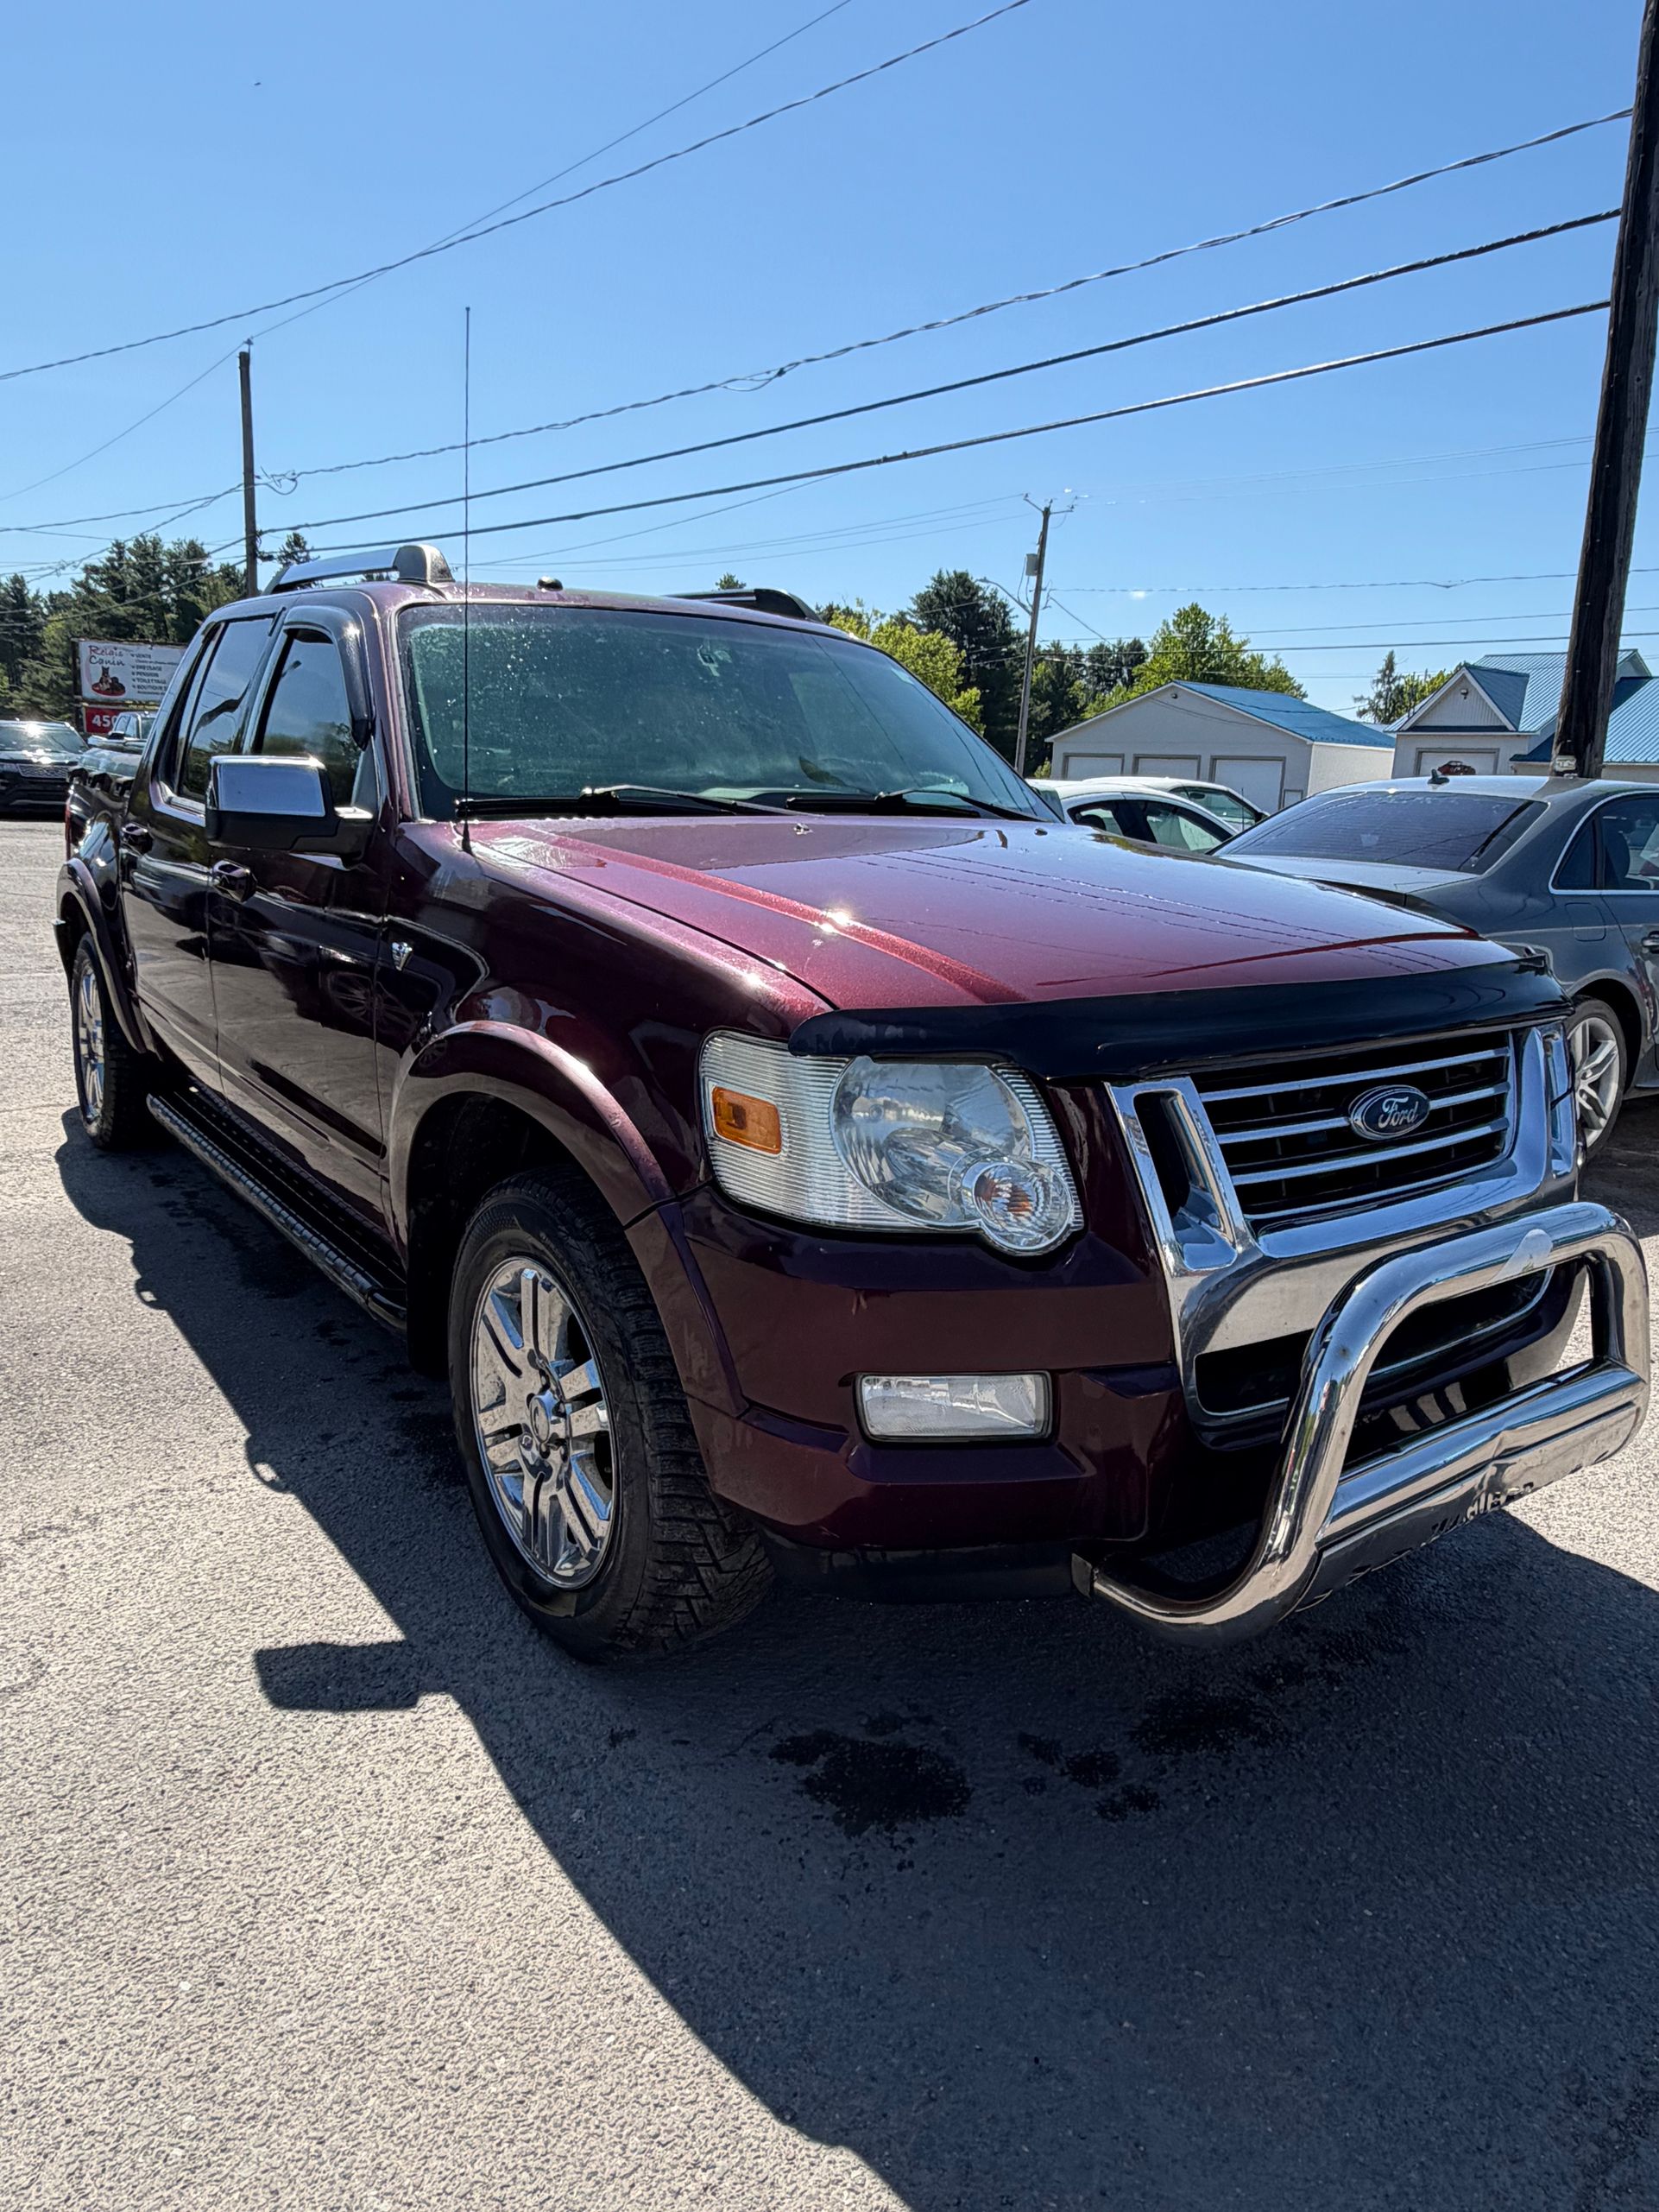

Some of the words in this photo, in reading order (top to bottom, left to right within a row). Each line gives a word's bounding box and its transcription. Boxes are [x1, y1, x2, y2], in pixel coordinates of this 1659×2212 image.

[88, 645, 123, 656] Relais
[89, 654, 124, 666] Canin
[1378, 1097, 1419, 1129] Ford
